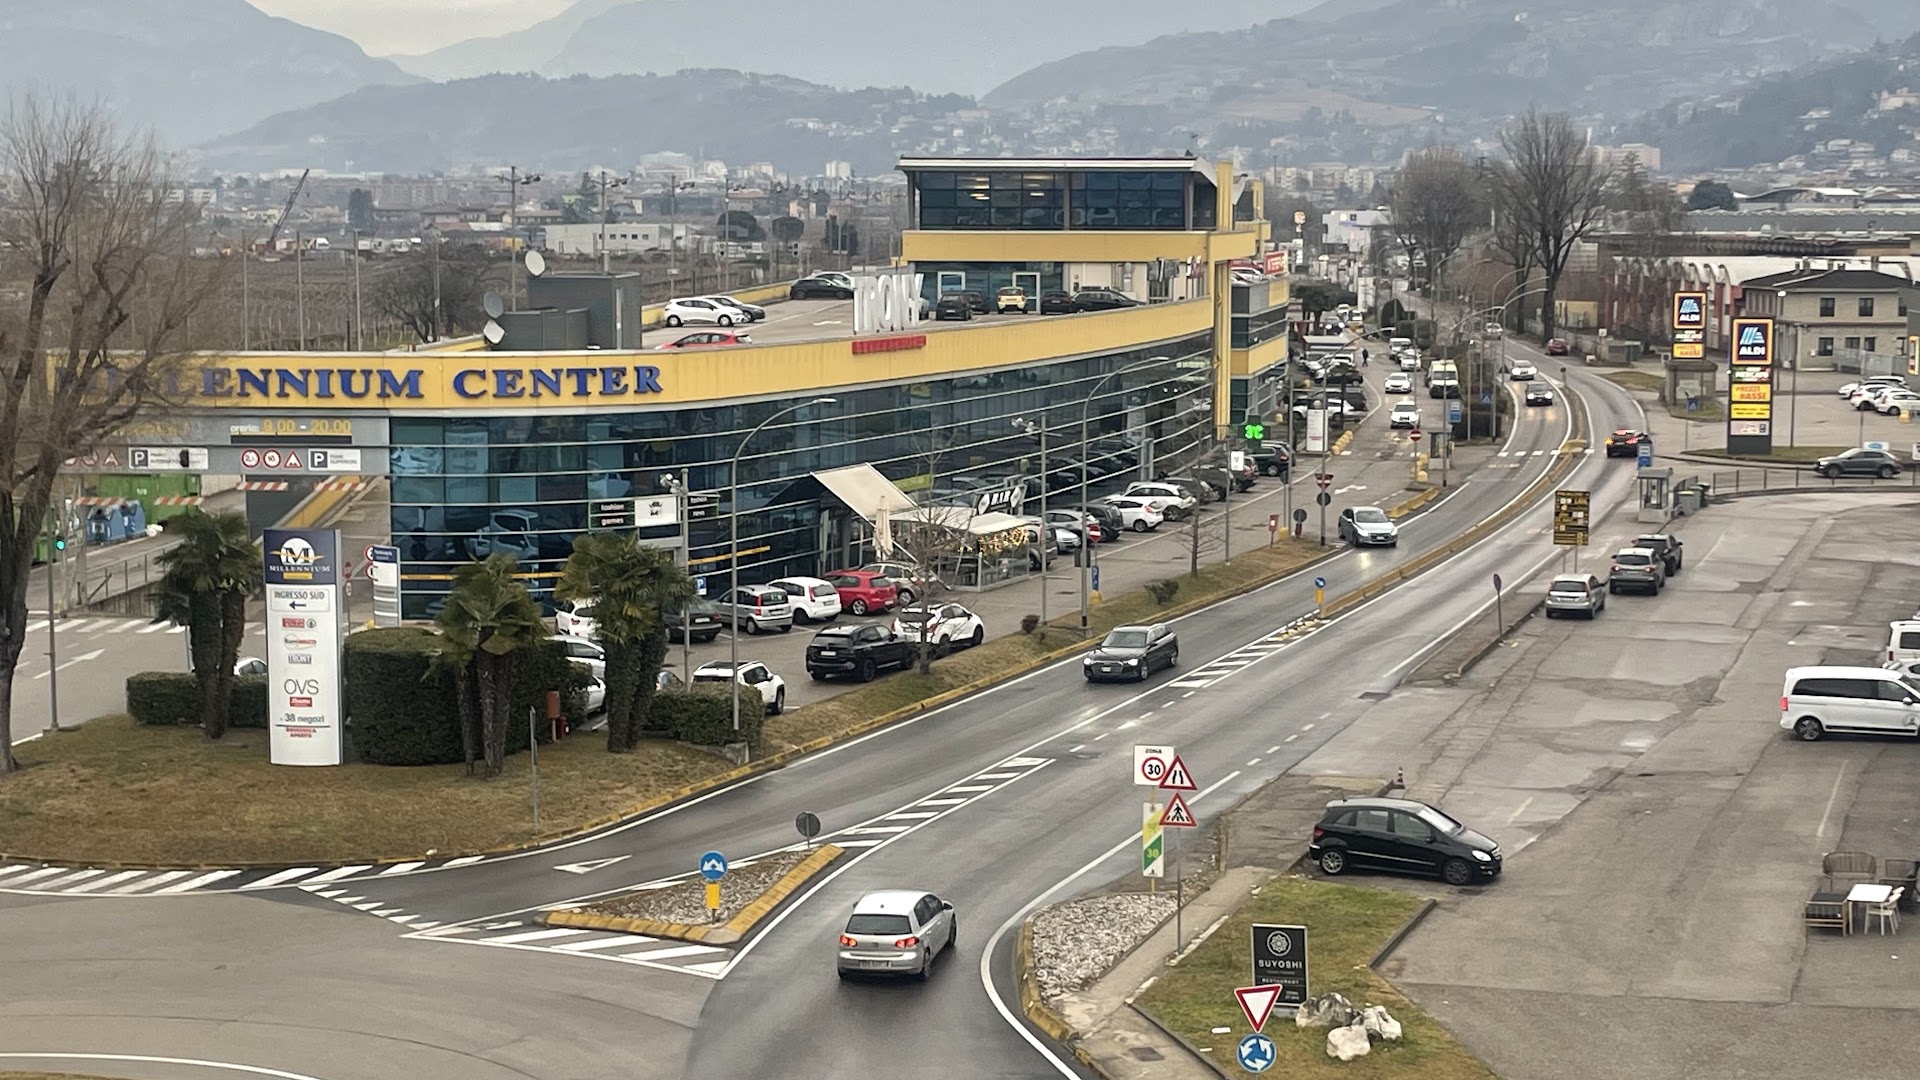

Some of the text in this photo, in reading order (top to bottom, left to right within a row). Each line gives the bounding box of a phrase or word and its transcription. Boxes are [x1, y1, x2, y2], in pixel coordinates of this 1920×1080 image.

[1739, 346, 1765, 356] ALDI
[453, 365, 663, 398] CENTER
[134, 452, 145, 466] P
[314, 453, 324, 466] P
[274, 591, 325, 599] INGRESSO SUD
[284, 679, 319, 695] OVS
[284, 713, 325, 724] 38 negozi
[1147, 764, 1161, 775] 30
[1146, 848, 1159, 859] 30
